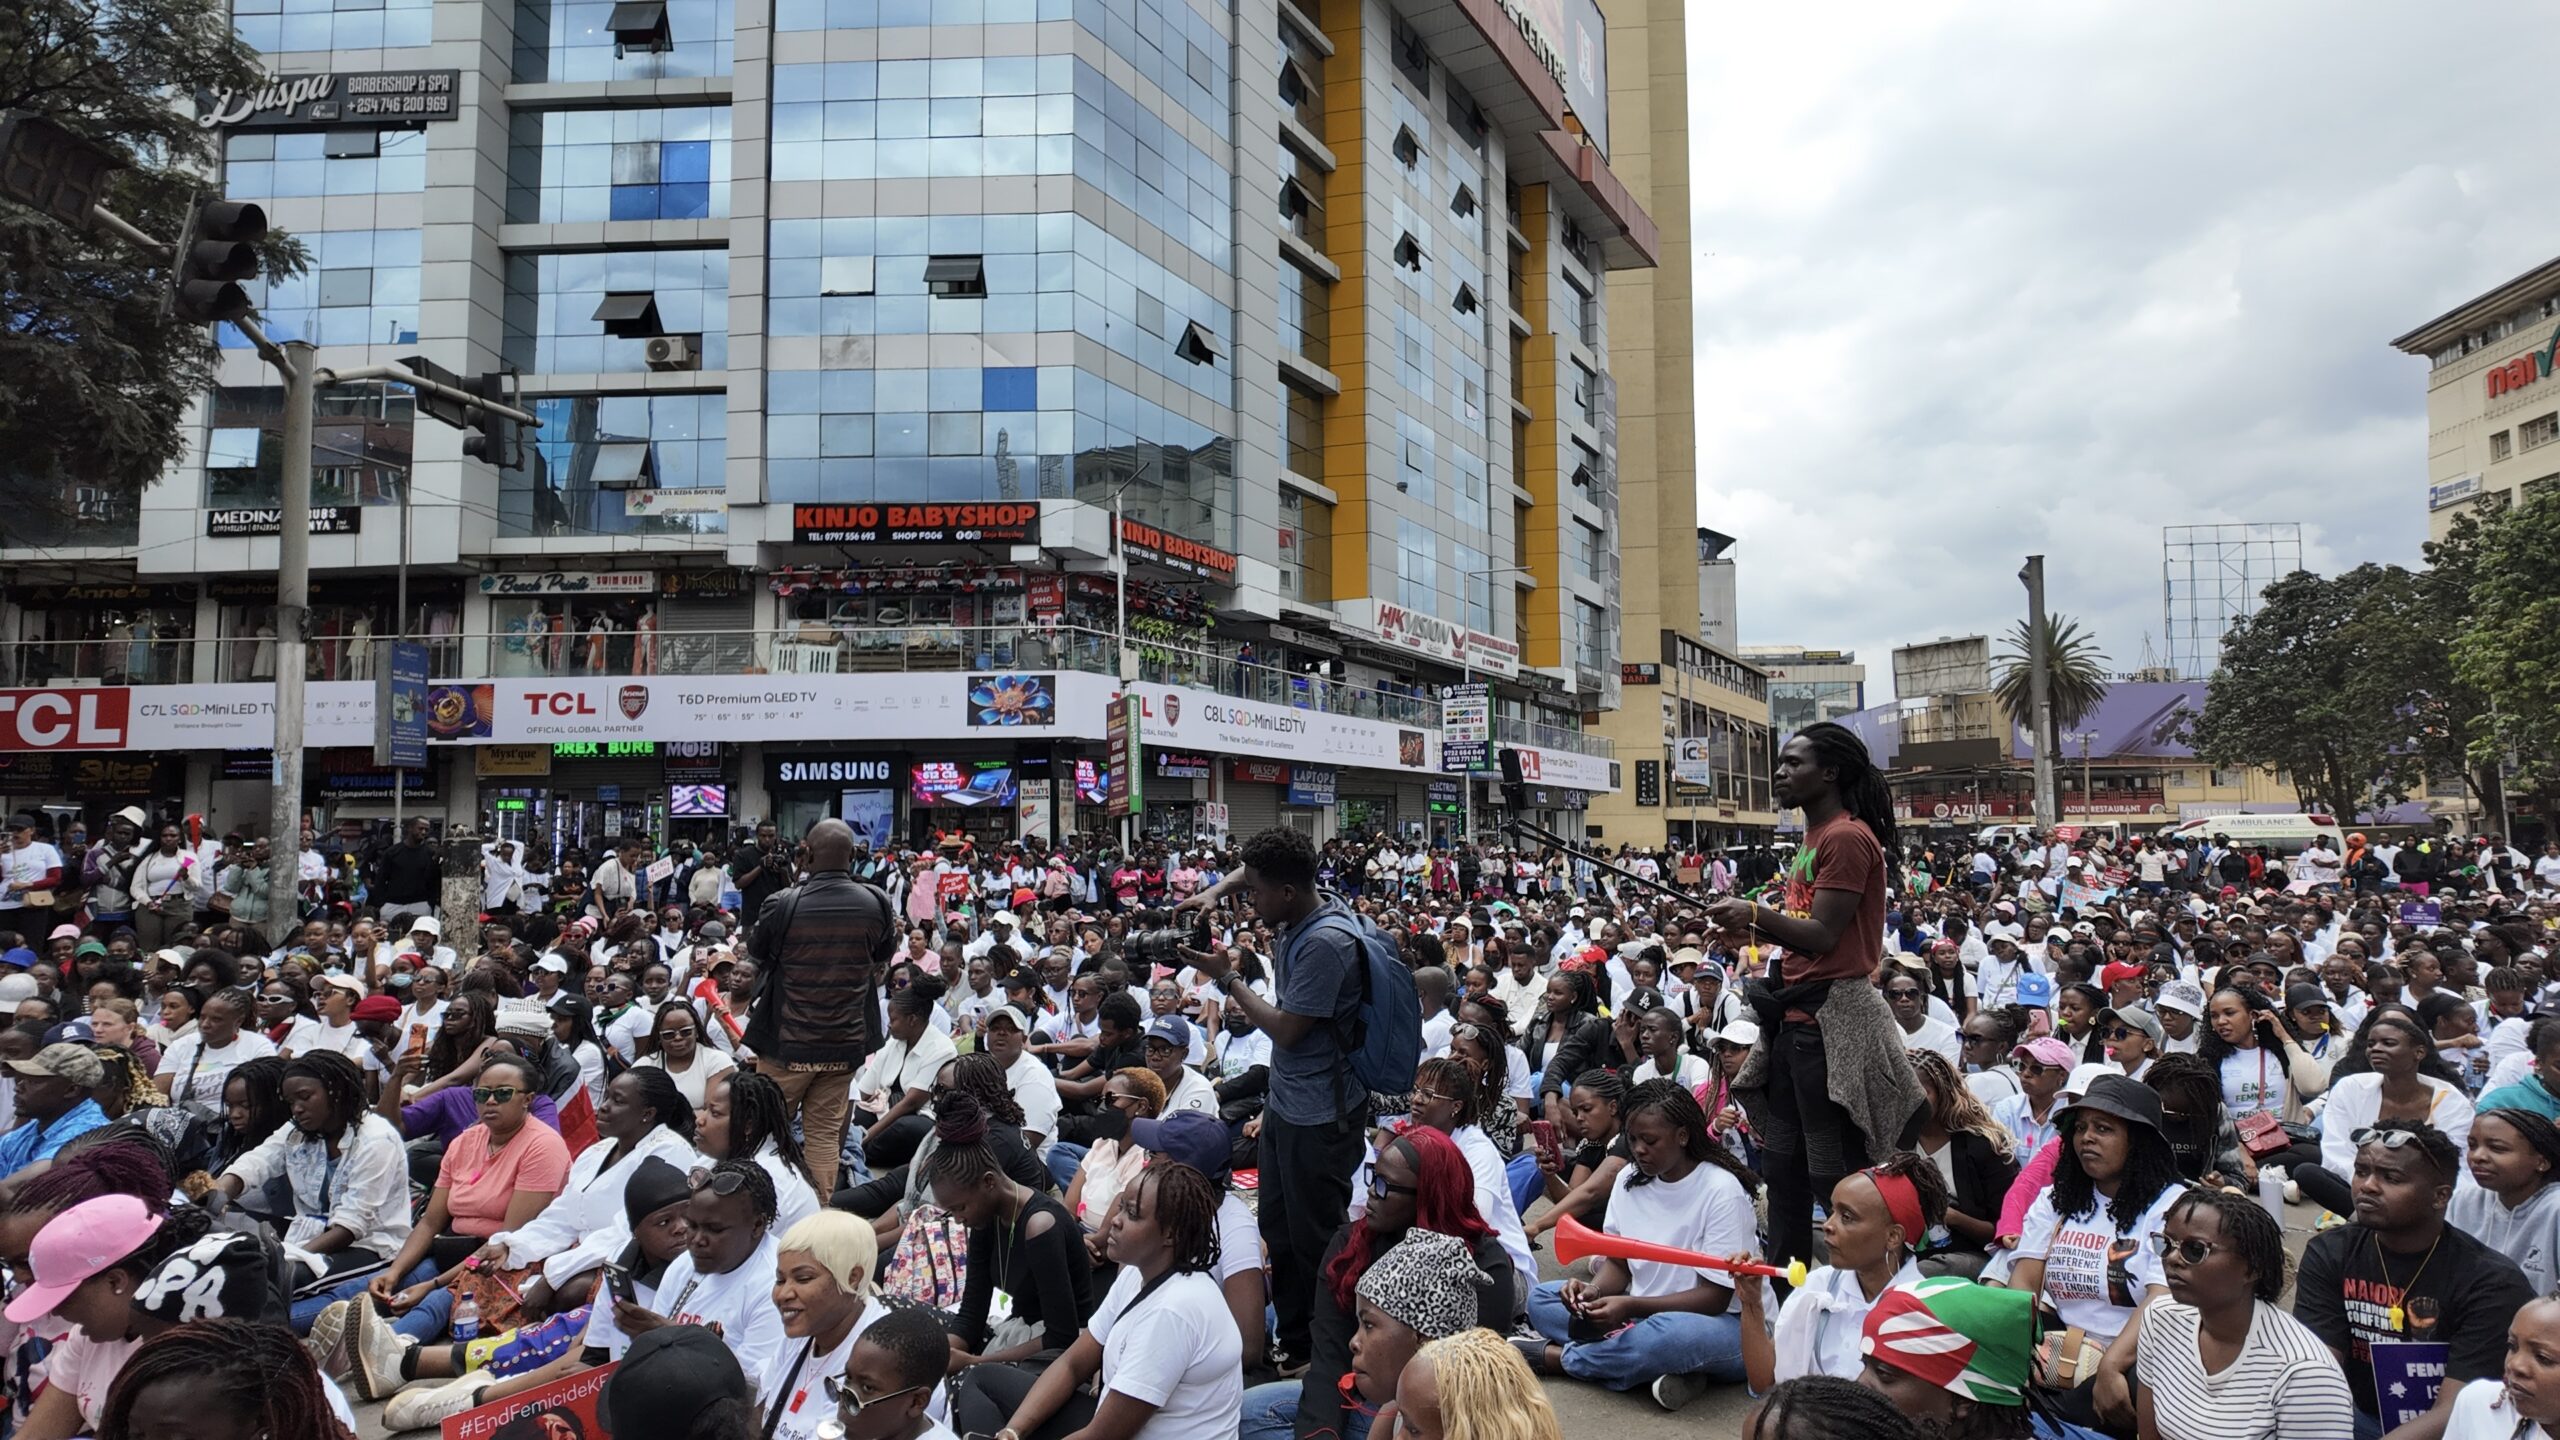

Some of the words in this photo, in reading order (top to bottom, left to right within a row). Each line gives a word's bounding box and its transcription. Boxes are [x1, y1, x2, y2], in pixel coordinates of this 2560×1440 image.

[347, 75, 417, 93] BARBERSHOP
[427, 74, 451, 91] SPA
[379, 96, 400, 112] 746
[402, 96, 425, 112] 200
[426, 95, 448, 112] 969
[795, 507, 879, 528] KINJO
[887, 505, 1037, 528] BABYSHOP
[808, 532, 824, 541] TEL:
[824, 532, 844, 541] 0797
[860, 531, 876, 541] 693
[892, 532, 918, 541] SHOP
[1164, 534, 1237, 573] BABYSHOP
[497, 573, 542, 594] Beach
[596, 576, 619, 585] SWIM
[622, 576, 643, 585] WEAR
[1378, 604, 1452, 645] HIKVISION
[1700, 619, 1723, 627] mate
[1381, 653, 1414, 669] COLLECTION
[2117, 672, 2157, 681] HOUSE
[1453, 683, 1489, 691] ELECTRON
[523, 691, 597, 716] TCL
[621, 690, 646, 699] Arsenal
[678, 694, 704, 705] T6D
[707, 692, 762, 706] Premium
[764, 692, 798, 703] QLED
[800, 691, 817, 703] TV
[0, 693, 120, 746] CL
[140, 704, 167, 717] C7L
[1204, 705, 1226, 724] C8L
[526, 726, 565, 734] OFFICIAL
[567, 725, 602, 734] GLOBAL
[604, 725, 644, 733] PARTNER
[1157, 730, 1179, 738] PARTNER
[1218, 733, 1228, 743] The
[1229, 734, 1240, 744] New
[666, 741, 718, 758] MOBI
[780, 761, 890, 781] SAMSUNG
[1248, 762, 1281, 777] HIKSEMI
[1518, 750, 1539, 778] CL
[1293, 769, 1329, 784] LAPTOP
[1428, 781, 1457, 792] ELECTRON
[338, 790, 387, 799] Computerized
[403, 790, 436, 798] Checkup
[1536, 791, 1548, 803] TCL
[1951, 804, 1992, 817] AZURI
[2065, 804, 2085, 813] AZUR
[2089, 804, 2141, 813] RESTAURANT
[2230, 818, 2295, 826] AMBULANCE
[1638, 991, 1651, 1010] LA
[2054, 1230, 2111, 1251] NAIROBI
[2050, 1246, 2102, 1260] INTERNATIONAL
[2047, 1256, 2101, 1270] CONFERENCE
[2046, 1271, 2100, 1284] PREVENTING
[2049, 1281, 2064, 1291] AND
[2065, 1282, 2100, 1294] ENDING
[2405, 1363, 2447, 1378] FEM
